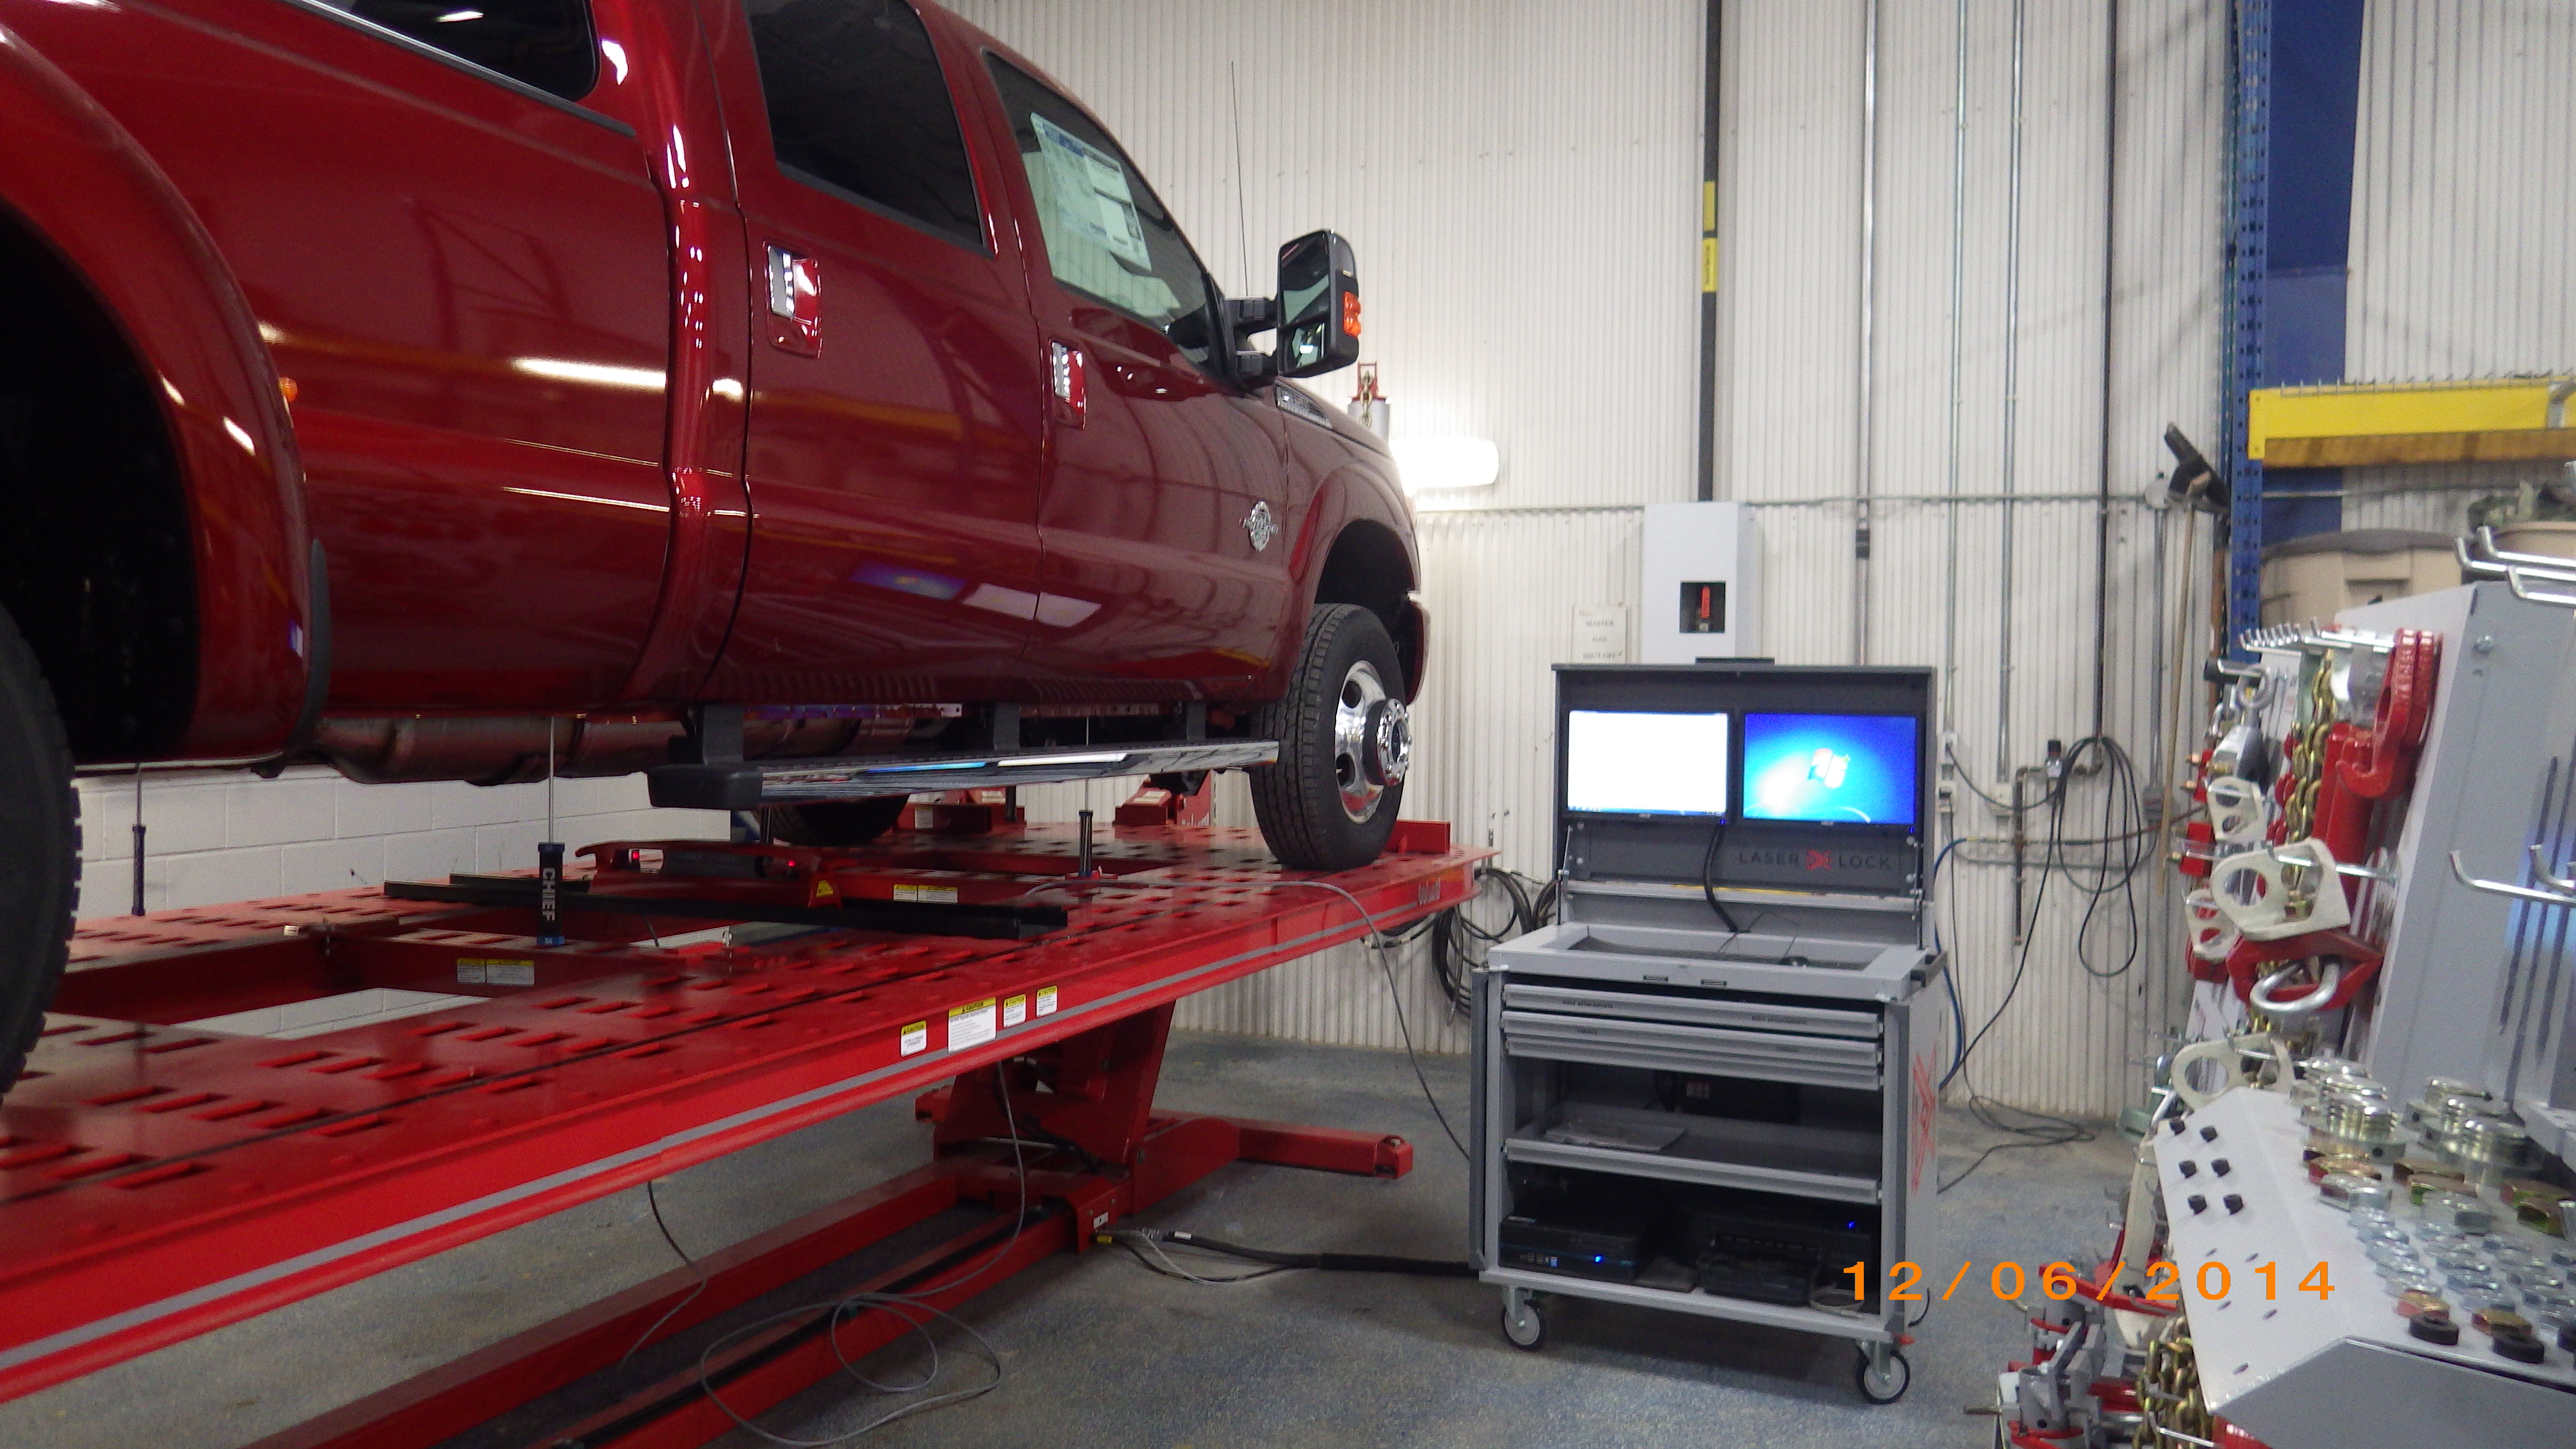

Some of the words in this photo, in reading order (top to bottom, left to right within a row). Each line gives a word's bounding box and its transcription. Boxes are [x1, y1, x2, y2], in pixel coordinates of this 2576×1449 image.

[1739, 851, 1800, 866] LASER
[1838, 855, 1891, 869] LOCK
[543, 868, 556, 922] CHIEF
